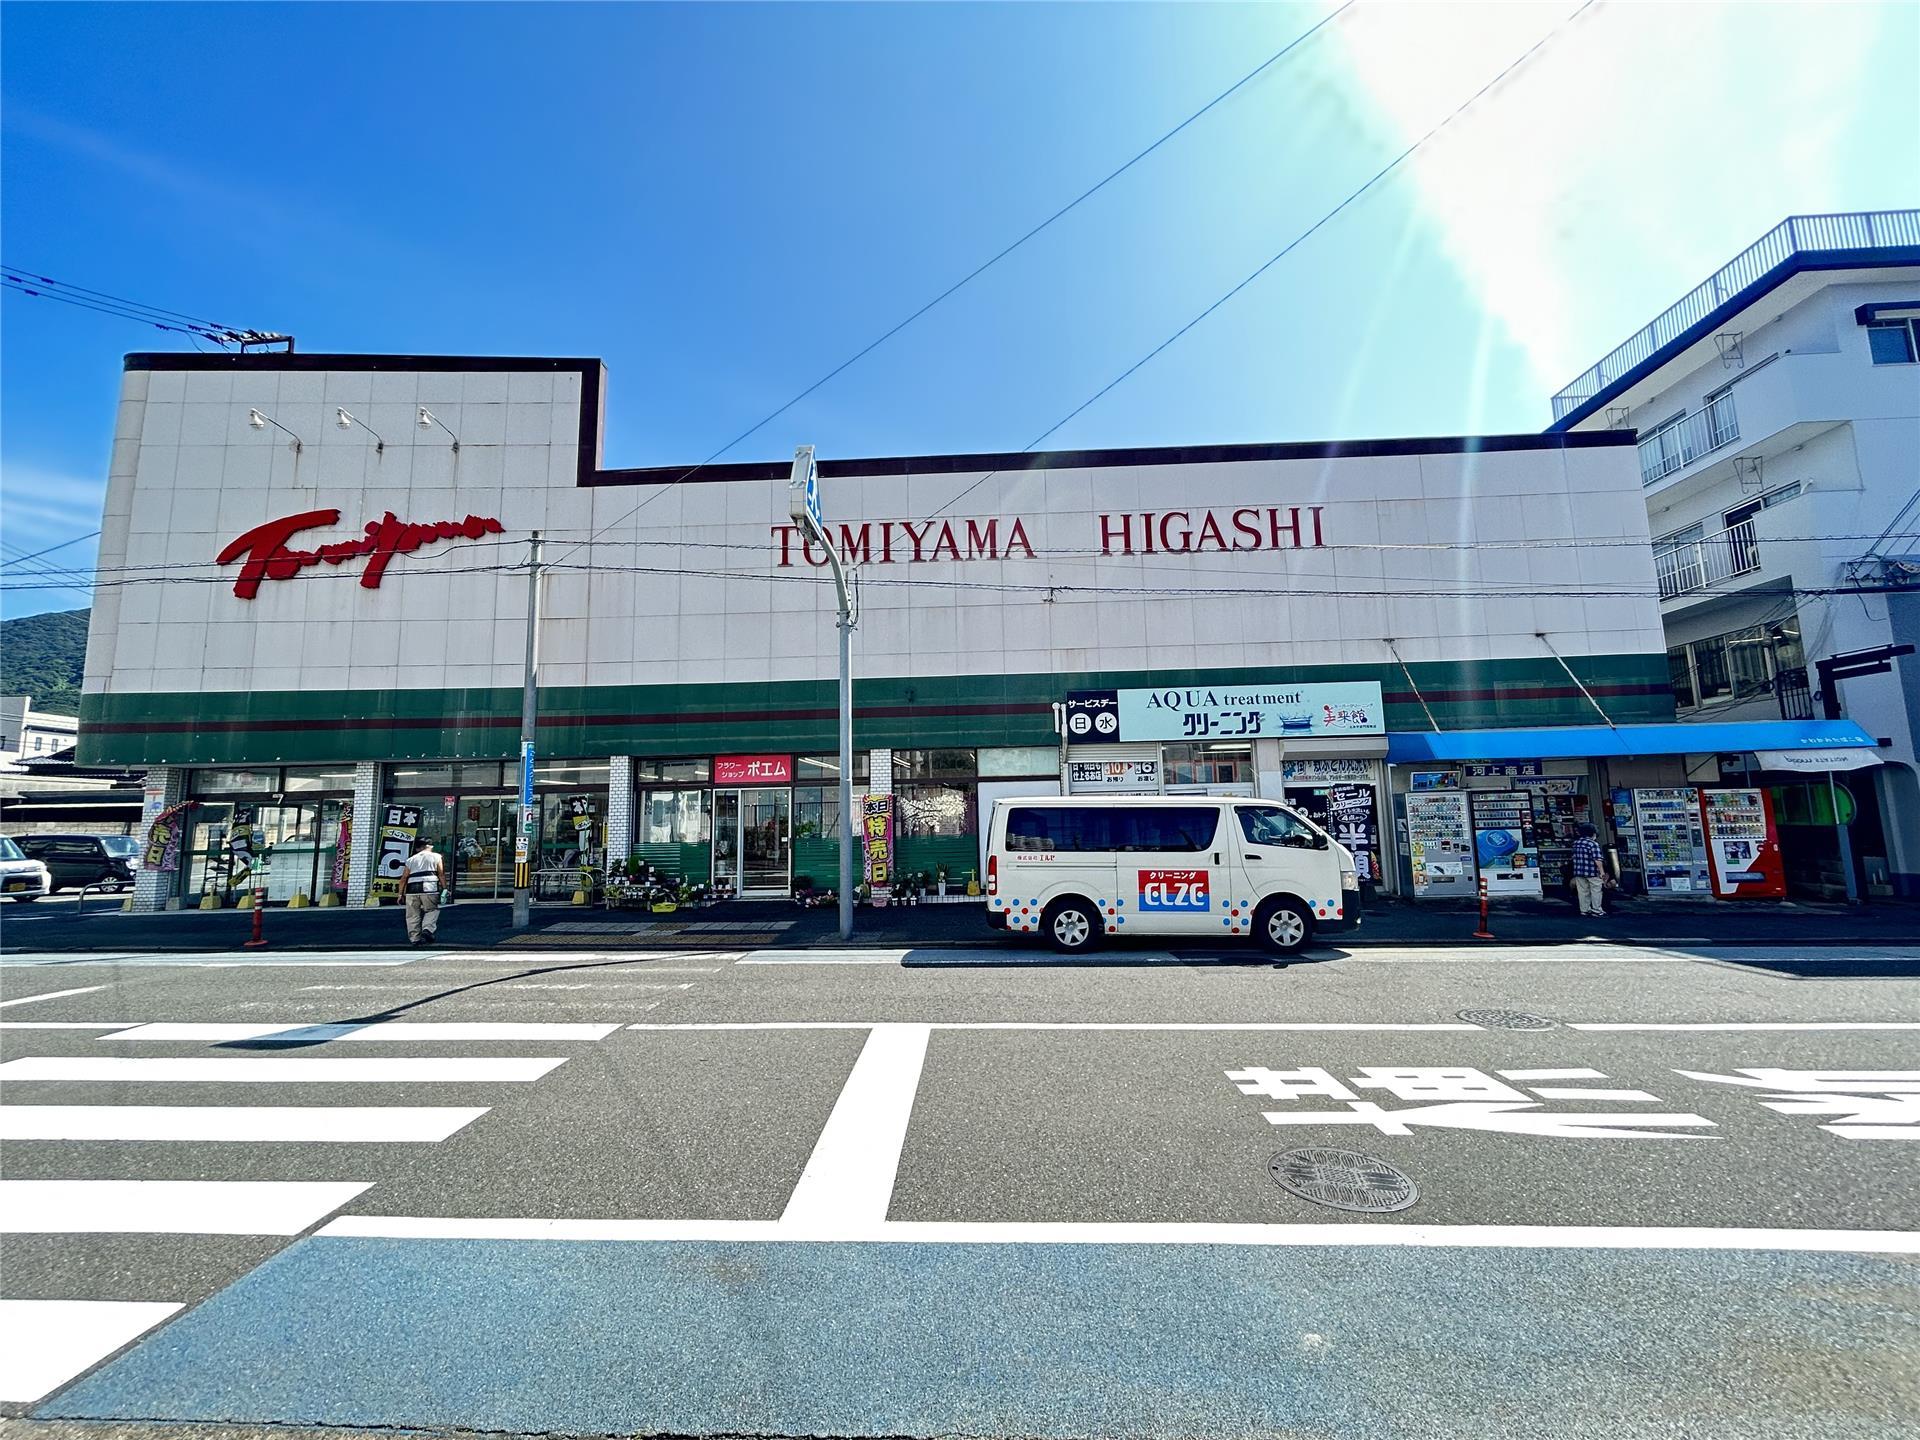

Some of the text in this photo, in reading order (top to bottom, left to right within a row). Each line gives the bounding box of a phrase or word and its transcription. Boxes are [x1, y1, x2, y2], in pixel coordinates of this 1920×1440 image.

[770, 506, 1325, 567] TOMIYAMA HIGASHI
[1067, 698, 1118, 708] サービスデー
[1146, 690, 1301, 711] AQUA treatment
[1075, 716, 1113, 729] 日 水
[1182, 711, 1266, 736] クリーニング
[747, 761, 786, 777] ポエム
[1472, 765, 1536, 776] 河上商店
[1333, 788, 1370, 801] セール
[865, 800, 888, 812] 本日
[1335, 798, 1370, 809] クリーニング
[867, 816, 888, 882] 特売日
[1149, 871, 1197, 880] クリーニング
